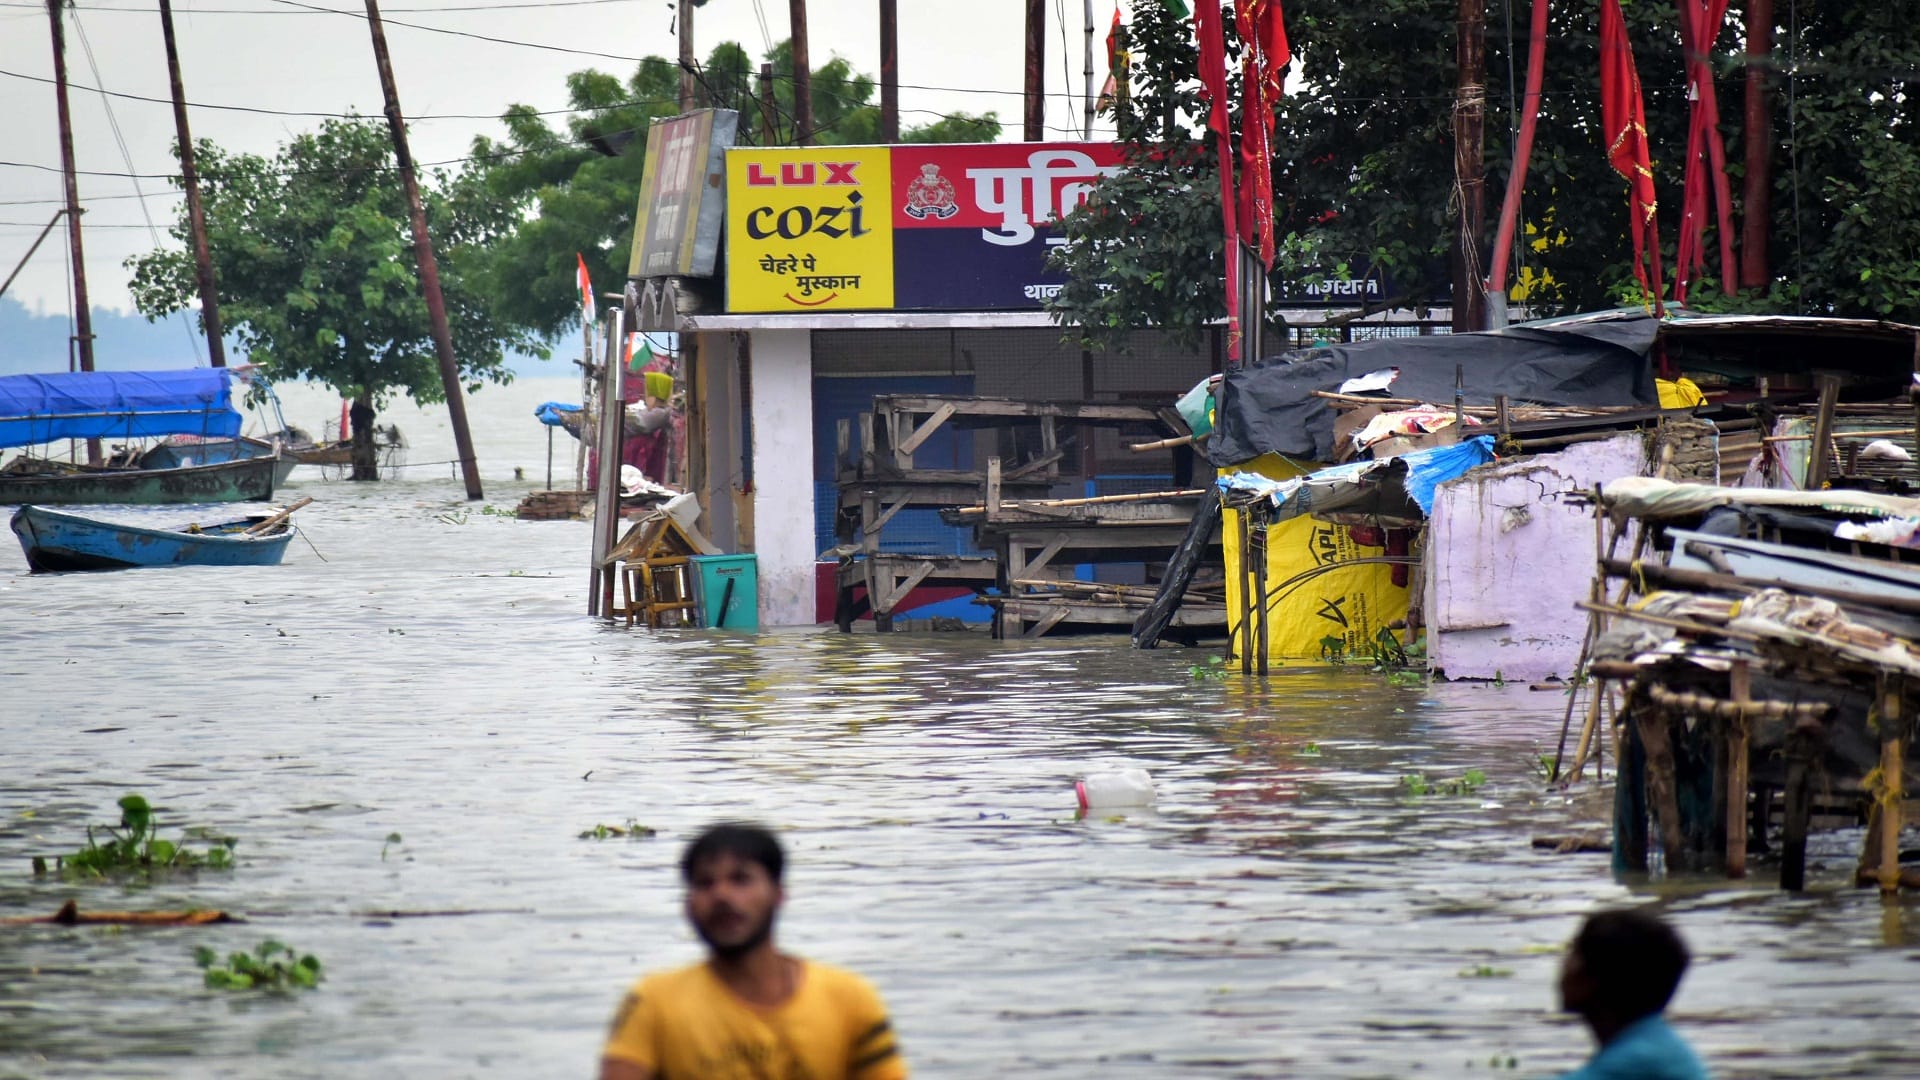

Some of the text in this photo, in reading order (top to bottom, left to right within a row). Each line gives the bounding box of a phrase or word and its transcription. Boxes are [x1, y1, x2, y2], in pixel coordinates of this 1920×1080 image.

[747, 162, 860, 186] LUX
[966, 150, 1132, 246] पुलि
[746, 190, 871, 240] cozi
[759, 253, 817, 275] चेहरे पे
[795, 275, 861, 297] मुस्कान
[1024, 284, 1064, 299] थान
[1320, 524, 1337, 563] APL
